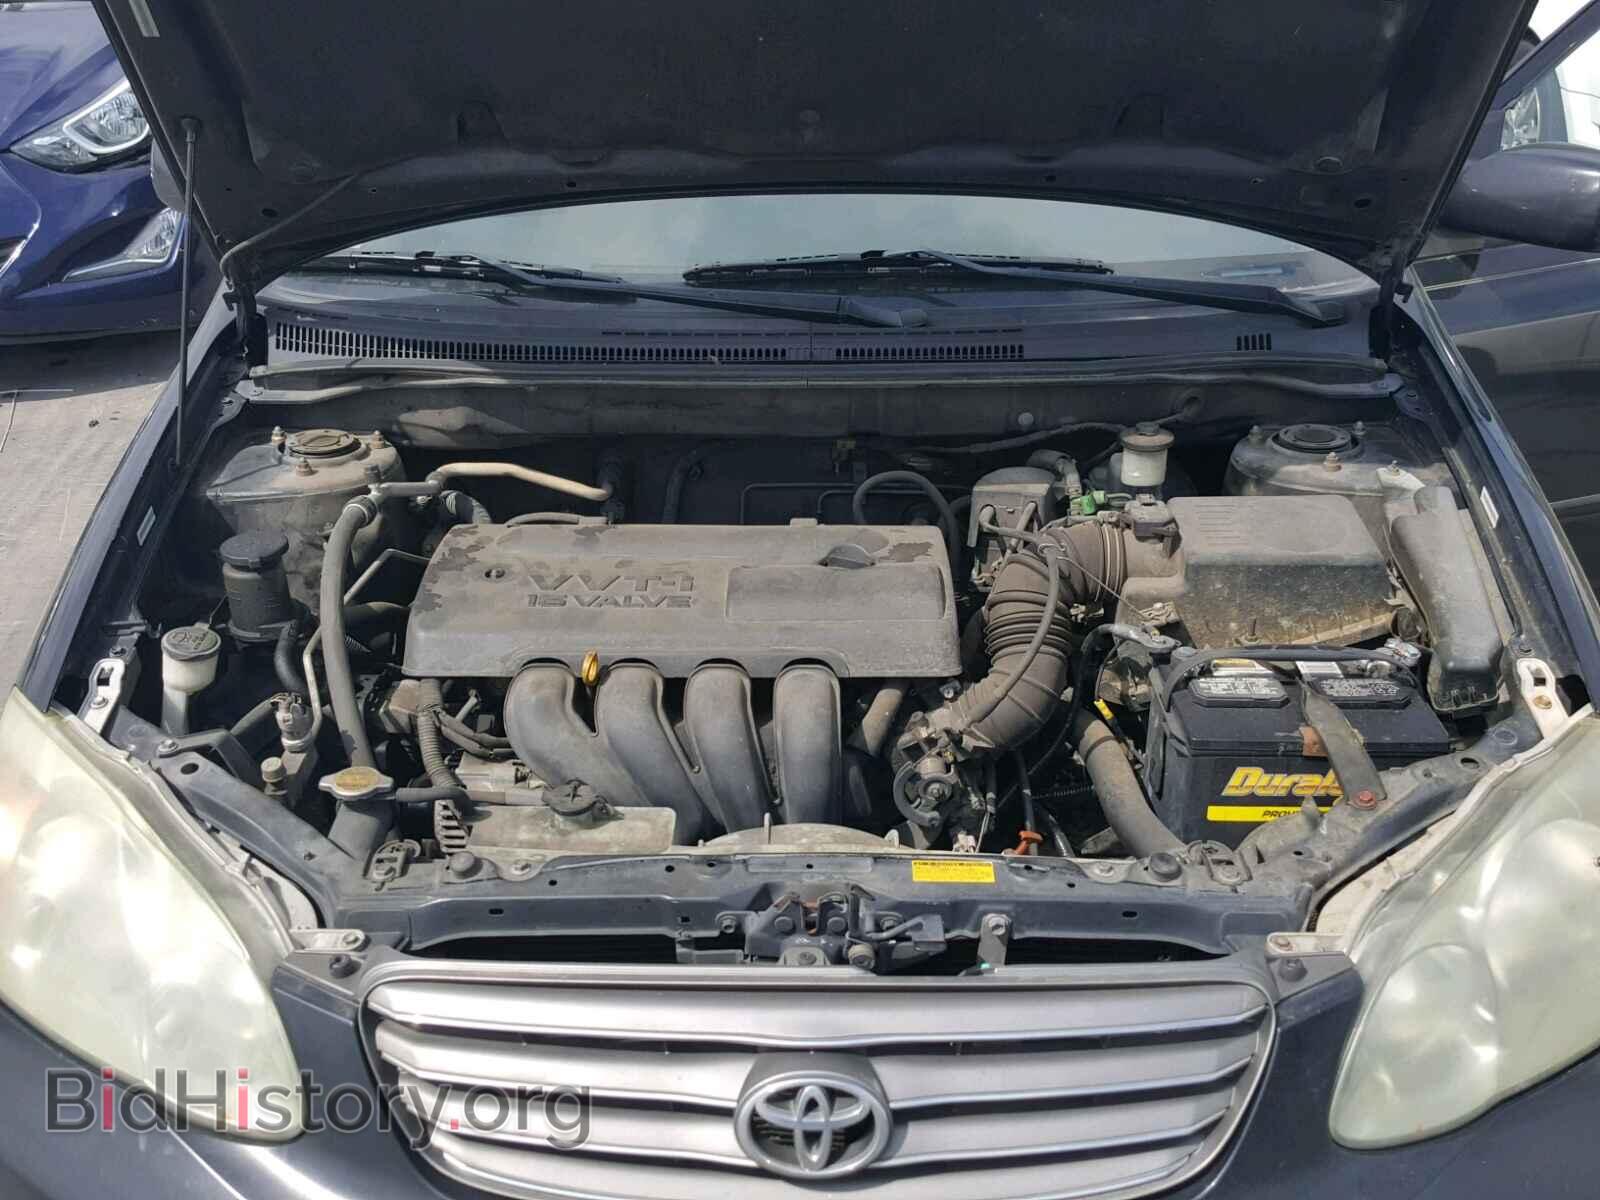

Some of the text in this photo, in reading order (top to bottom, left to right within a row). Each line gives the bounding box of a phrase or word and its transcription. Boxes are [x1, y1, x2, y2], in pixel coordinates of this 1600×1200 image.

[528, 594, 692, 608] 16 VALVE
[1222, 767, 1344, 797] Dural
